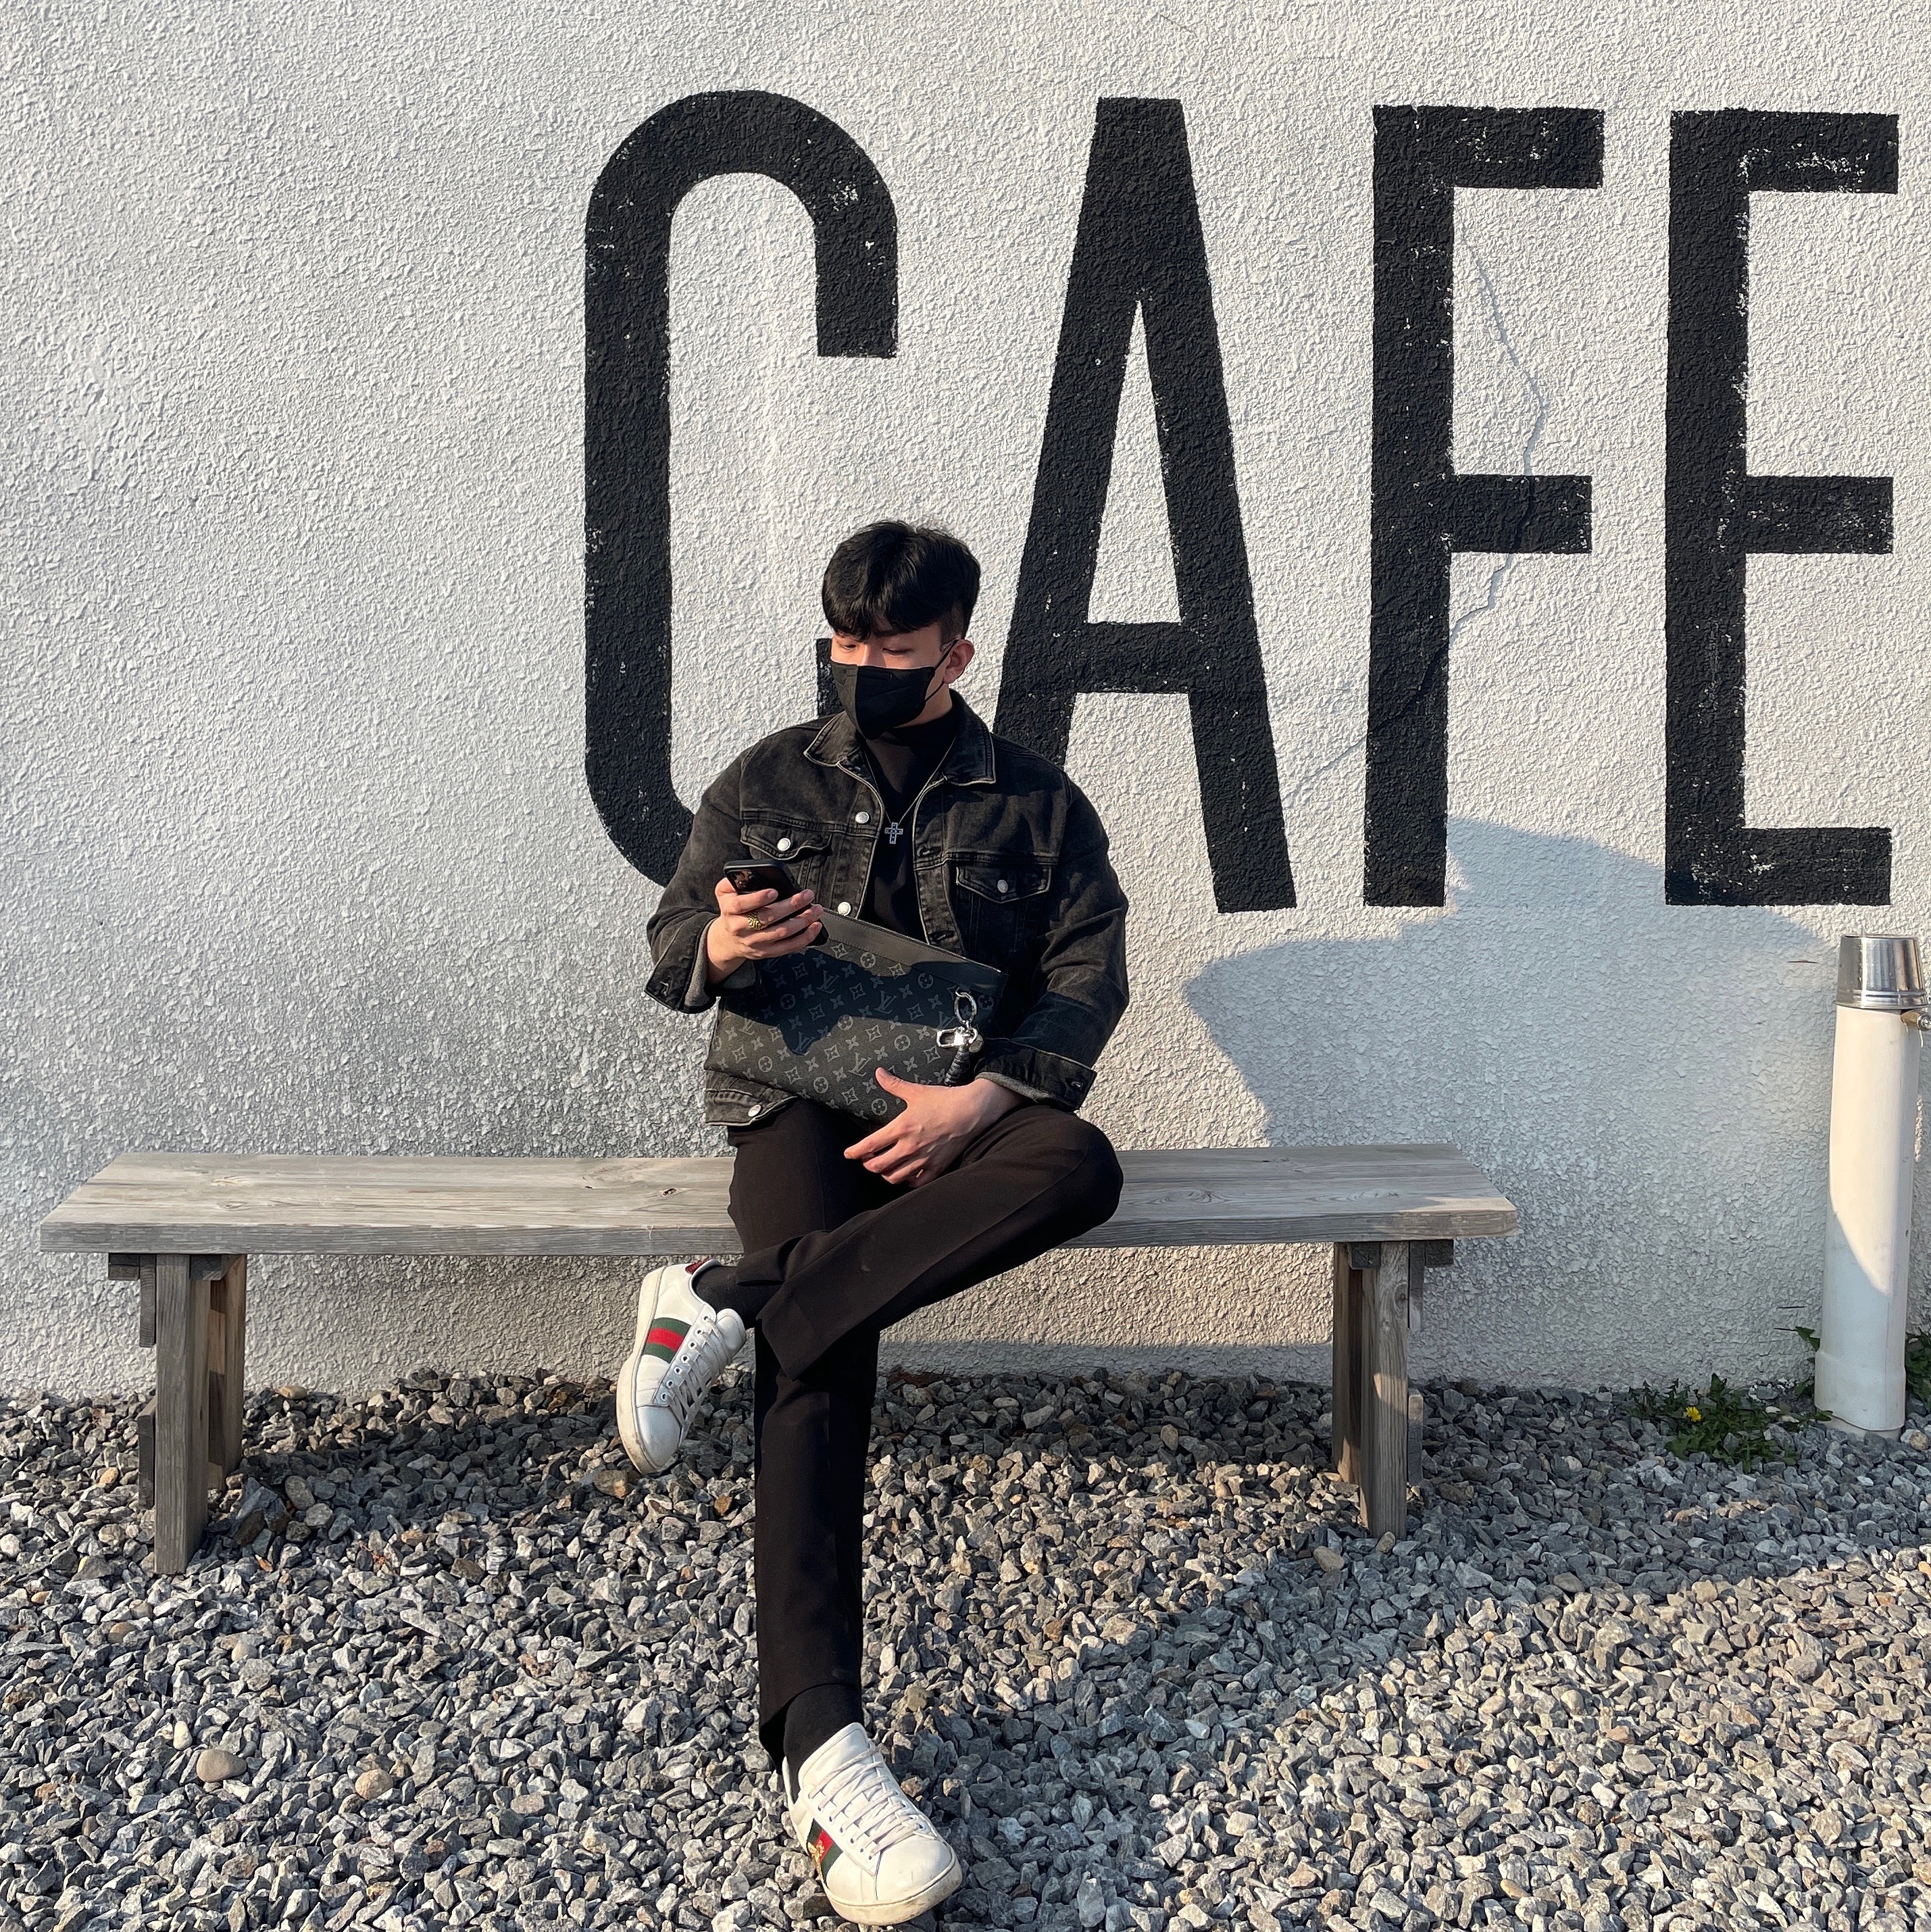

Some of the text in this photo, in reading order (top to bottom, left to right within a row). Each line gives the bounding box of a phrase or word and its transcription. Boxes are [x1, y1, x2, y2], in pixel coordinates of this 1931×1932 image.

[585, 91, 1899, 912] CAFE
[816, 970, 839, 994] LV
[874, 991, 897, 1014] LV
[848, 1052, 872, 1076] LV
